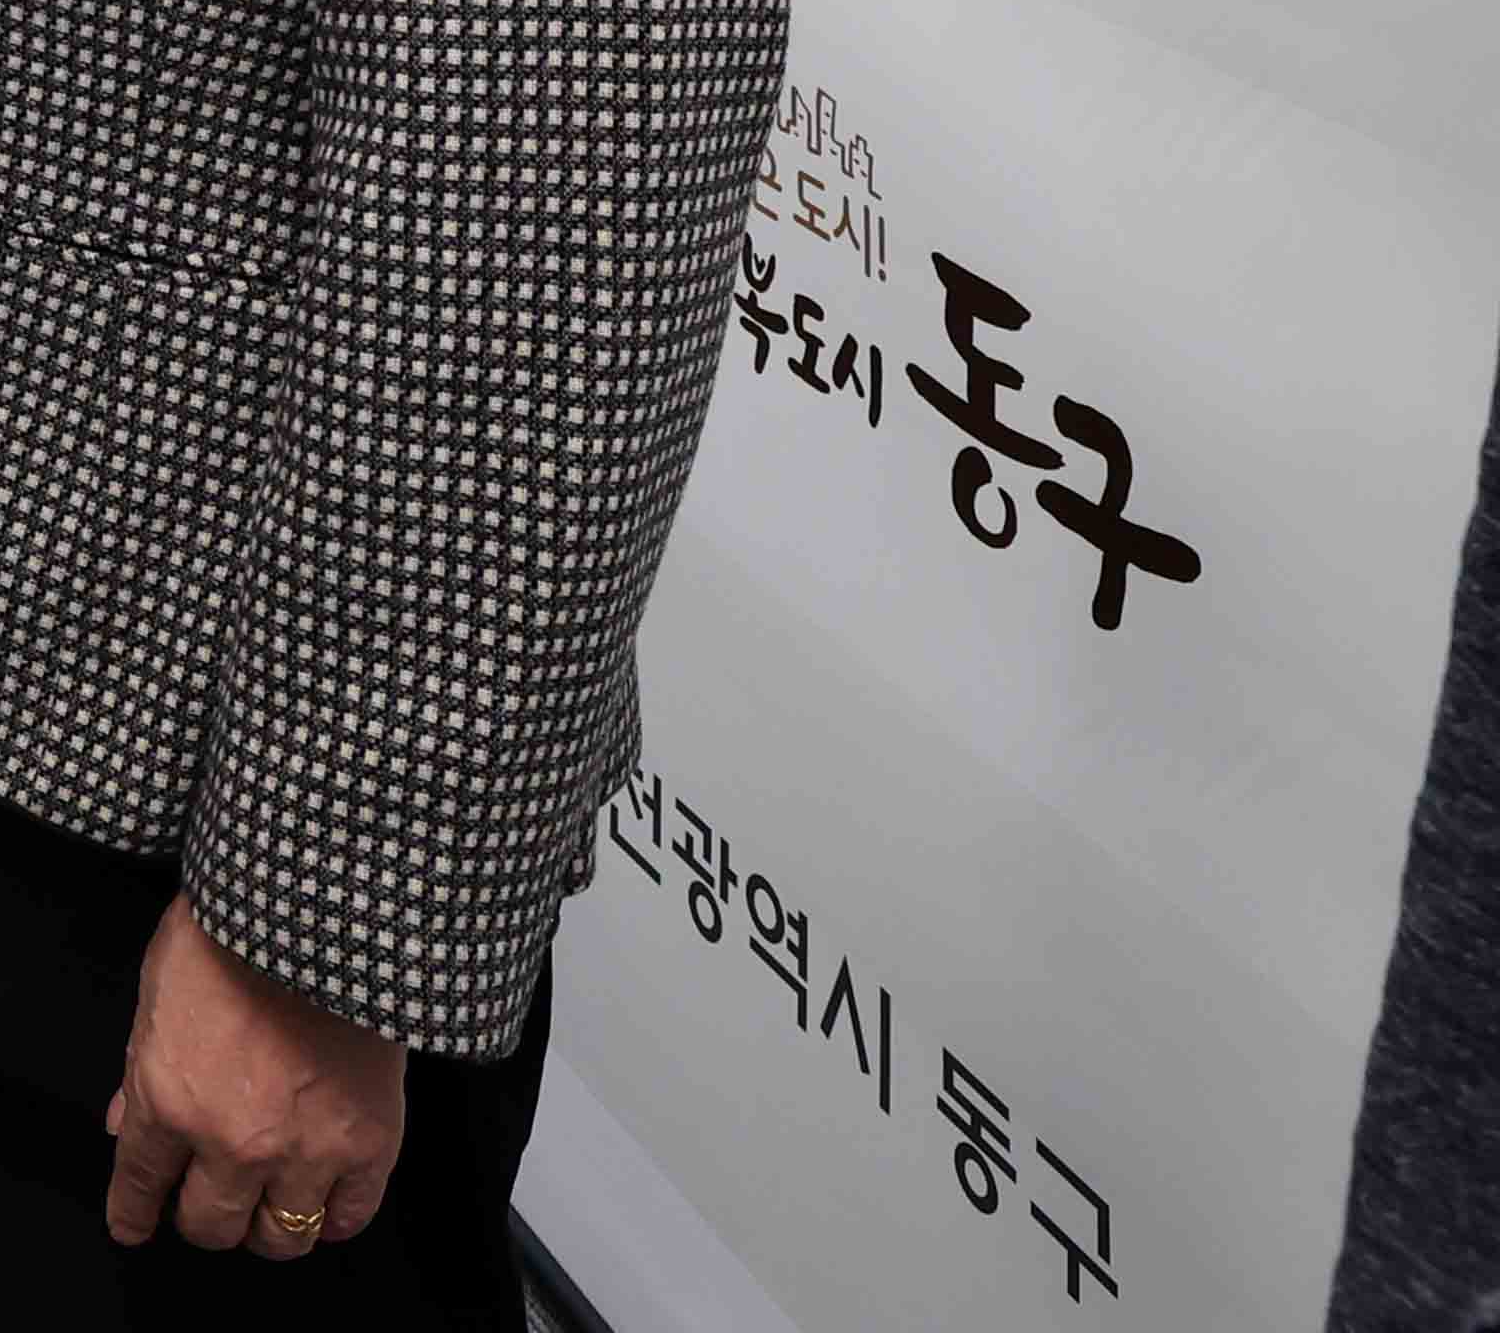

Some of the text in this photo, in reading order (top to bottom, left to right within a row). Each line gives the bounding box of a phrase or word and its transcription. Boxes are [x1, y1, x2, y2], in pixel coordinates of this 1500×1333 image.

[792, 169, 887, 283] 도시!
[905, 251, 1202, 631] 동구
[936, 1045, 1119, 1305] 동구
